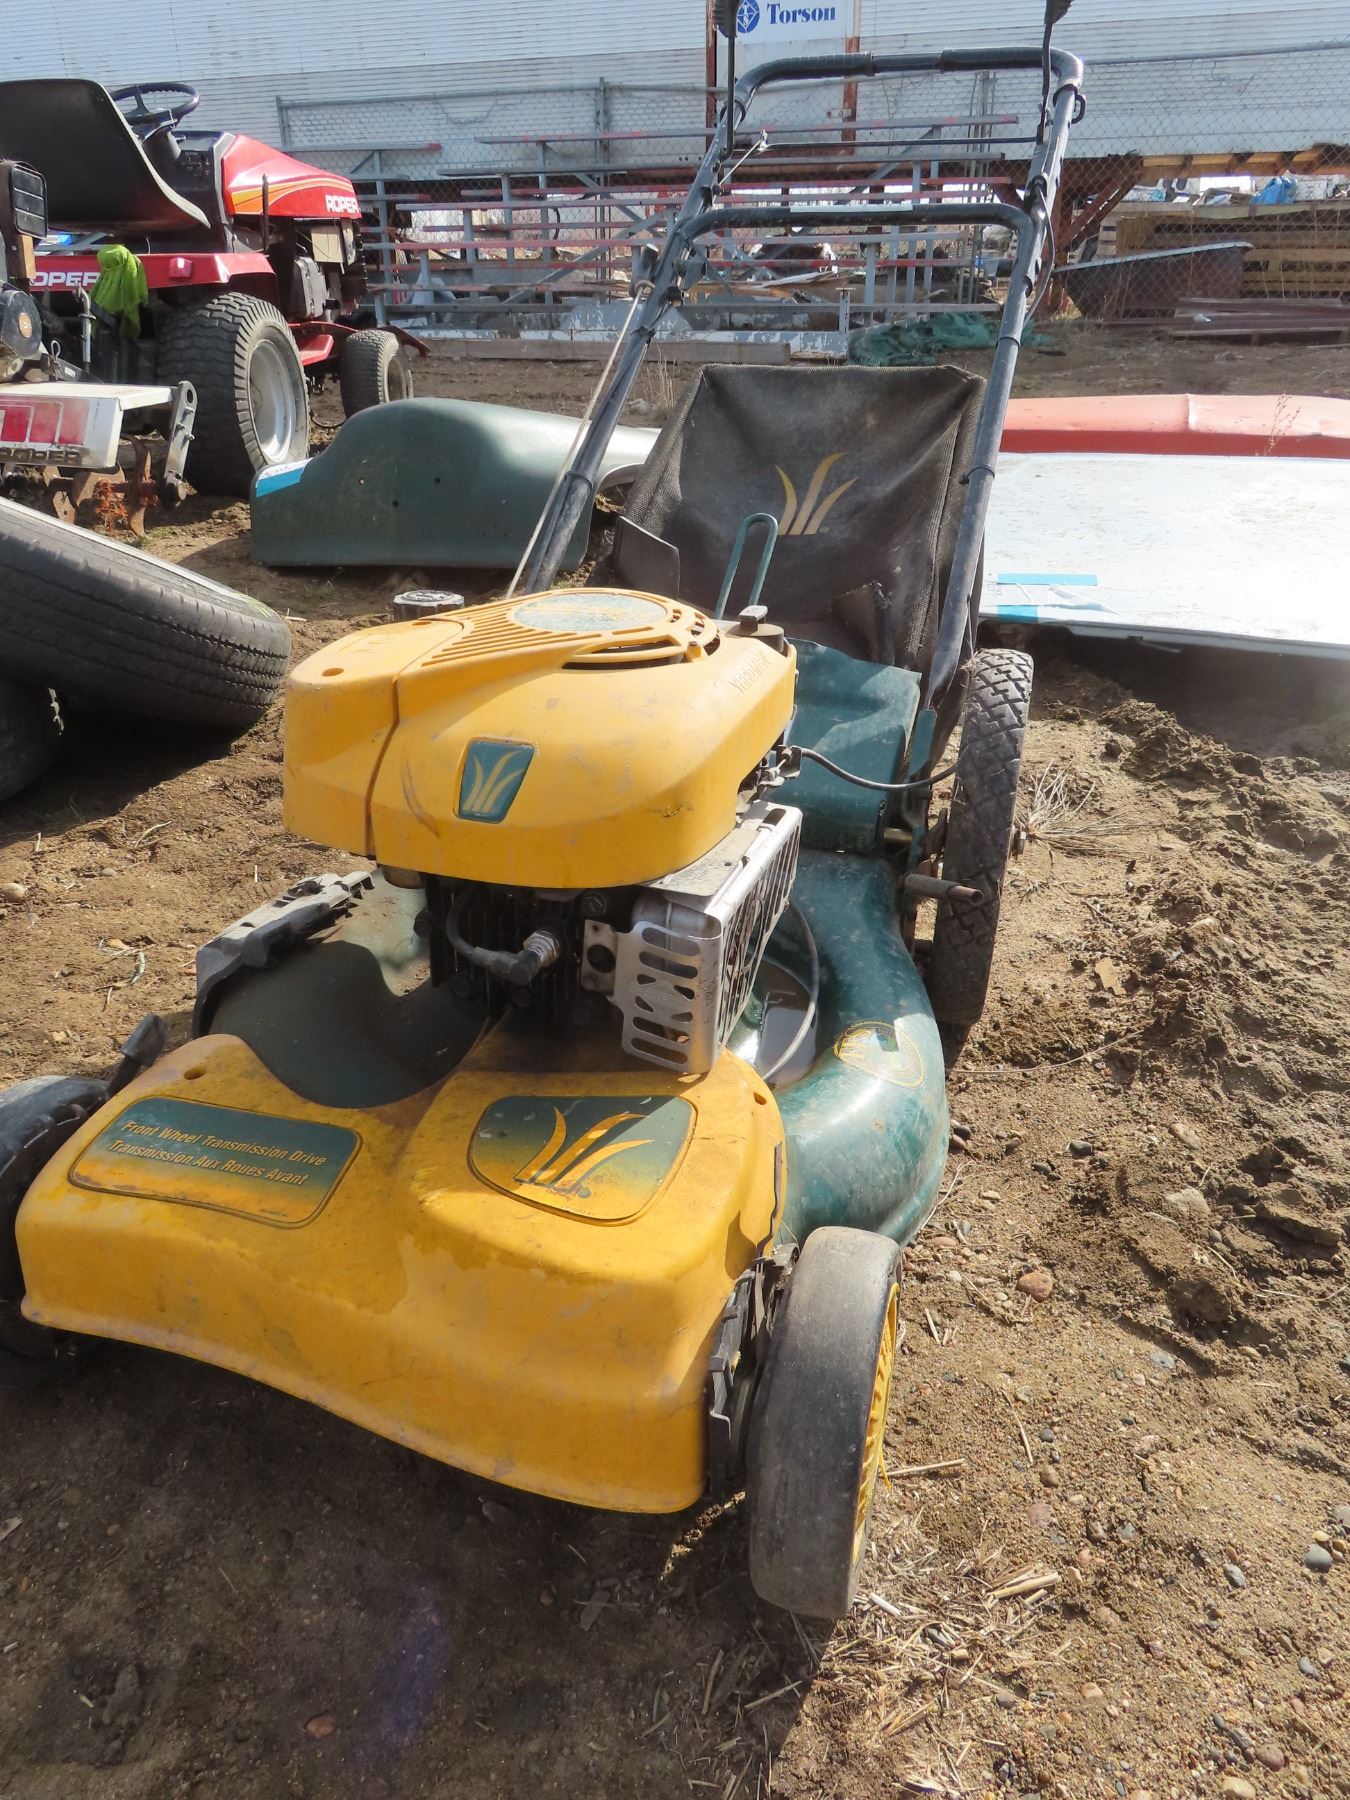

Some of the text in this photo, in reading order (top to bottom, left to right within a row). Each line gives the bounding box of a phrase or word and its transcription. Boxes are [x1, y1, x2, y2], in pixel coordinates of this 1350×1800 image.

[767, 3, 836, 24] Torson
[325, 195, 360, 213] ROPER
[30, 271, 101, 287] OPER
[121, 1120, 327, 1167] Front Wheel Transmission Drive
[109, 1140, 309, 1185] Transmission Aux Roues Avant
